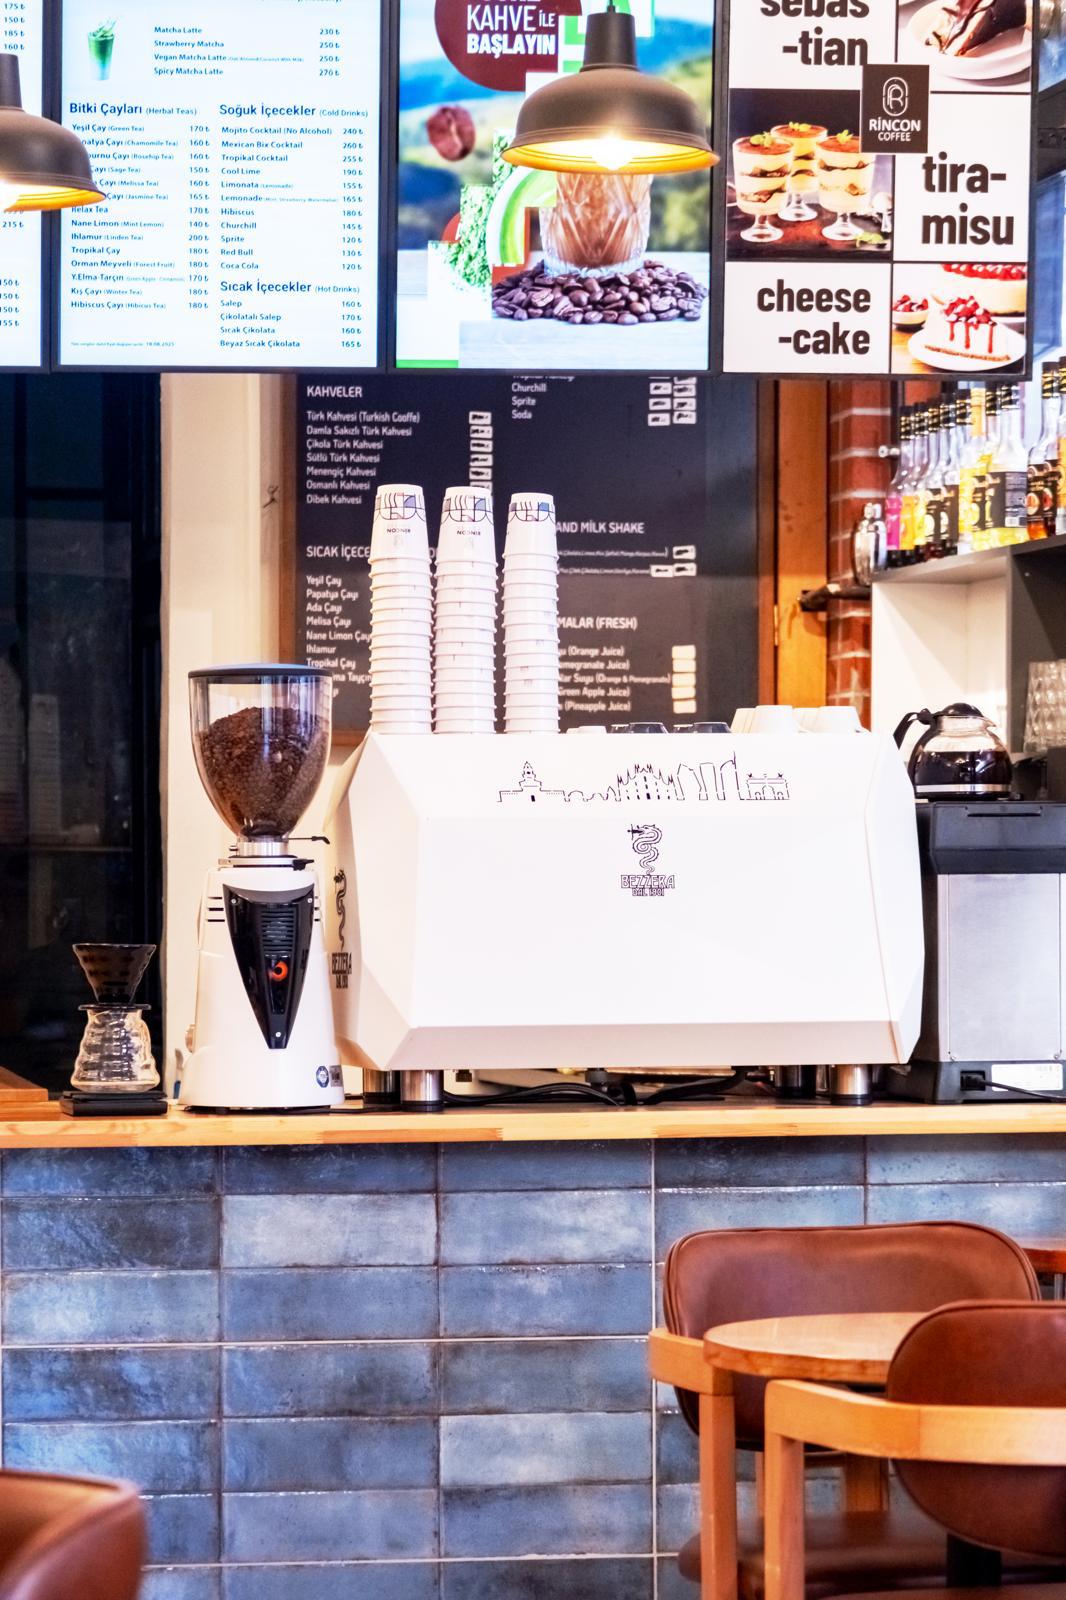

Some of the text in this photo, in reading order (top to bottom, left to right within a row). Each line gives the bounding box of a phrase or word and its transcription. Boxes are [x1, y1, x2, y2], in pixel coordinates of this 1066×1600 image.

[467, 4, 556, 32] KAHVE İLE
[154, 40, 195, 48] Strawberry
[467, 33, 556, 59] BAŞLAYIN
[782, 26, 869, 67] -tian
[154, 67, 174, 76] Spicy
[70, 103, 96, 113] Bitki
[100, 103, 142, 116] Çayları
[220, 104, 256, 117] Soğuk
[261, 103, 316, 118] İçecekler
[92, 124, 106, 132] Çay
[869, 116, 921, 133] RİNCON
[222, 127, 248, 135] Mojito
[878, 130, 913, 142] COFFEE
[222, 154, 254, 162] Tropikal
[920, 150, 1006, 193] tira-
[96, 205, 108, 213] Tea
[922, 202, 1014, 245] misu
[221, 235, 244, 243] Sprite
[72, 246, 120, 255] Tropikal Çay
[100, 260, 131, 268] Meyveli
[221, 281, 252, 291] Sıcak
[257, 279, 311, 294] İçecekler
[757, 279, 871, 313] cheese
[106, 301, 124, 310] Çayı
[221, 300, 242, 308] Salep
[260, 313, 282, 322] Salep
[220, 340, 243, 348] Beyaz
[778, 322, 870, 355] -cake
[307, 386, 362, 398] KAHVELER
[511, 382, 547, 392] Churchill
[512, 396, 536, 407] Sprite
[307, 410, 325, 421] Türk
[327, 411, 357, 422] Kahvesi
[359, 411, 390, 422] (Turkish
[512, 409, 532, 419] Soda
[306, 425, 412, 436] Damla Sakızlı Türk Kahvesi
[306, 438, 383, 450] Çikola Türk Kahvesi
[306, 452, 380, 463] Sütlü Türk Kahvesi
[306, 466, 376, 478] Menengiç Kahvesi
[306, 479, 370, 490] Osmanlı Kahvesi
[306, 494, 362, 504] Dibek Kahvesi
[580, 520, 606, 533] MİLK
[609, 522, 644, 534] SHAKE
[306, 545, 339, 557] SICAK
[306, 575, 342, 587] Yeşil Çay
[306, 588, 359, 601] Papatya Çayı
[306, 602, 342, 615] Ada Çayı
[306, 616, 351, 628] Melisa Çayı
[596, 616, 638, 630] (FRESH)
[306, 631, 353, 640] Nane Limon
[568, 645, 625, 658] (Orange Juice)
[305, 658, 356, 670] Tropikal Çay
[606, 659, 630, 670] Juice)
[582, 687, 630, 698] Apple Juice)
[564, 700, 631, 712] (Pineapple Juice)
[621, 874, 675, 888] BEZZERA
